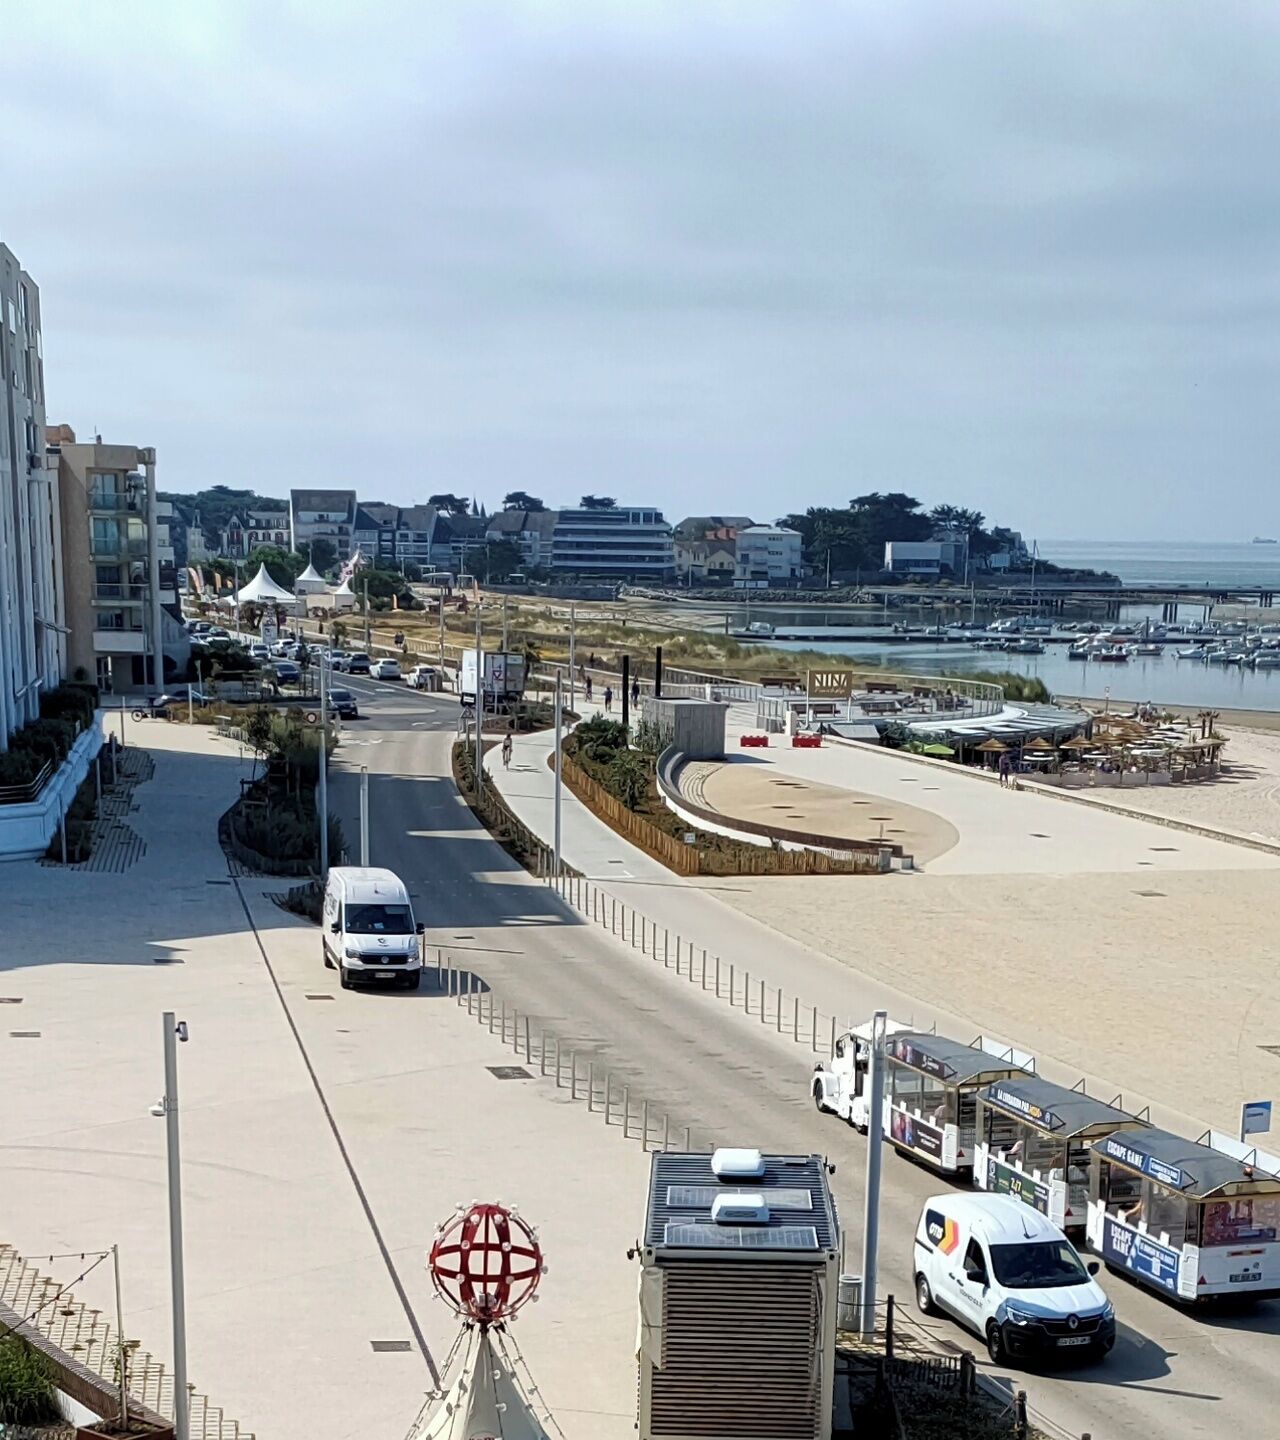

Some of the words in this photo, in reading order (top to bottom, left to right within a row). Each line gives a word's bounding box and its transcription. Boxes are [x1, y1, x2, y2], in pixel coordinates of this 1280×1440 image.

[1107, 1140, 1127, 1160] ESCAPE
[1127, 1149, 1143, 1168] GAME
[929, 1222, 944, 1240] OTIS
[1111, 1223, 1132, 1246] ESCAPE
